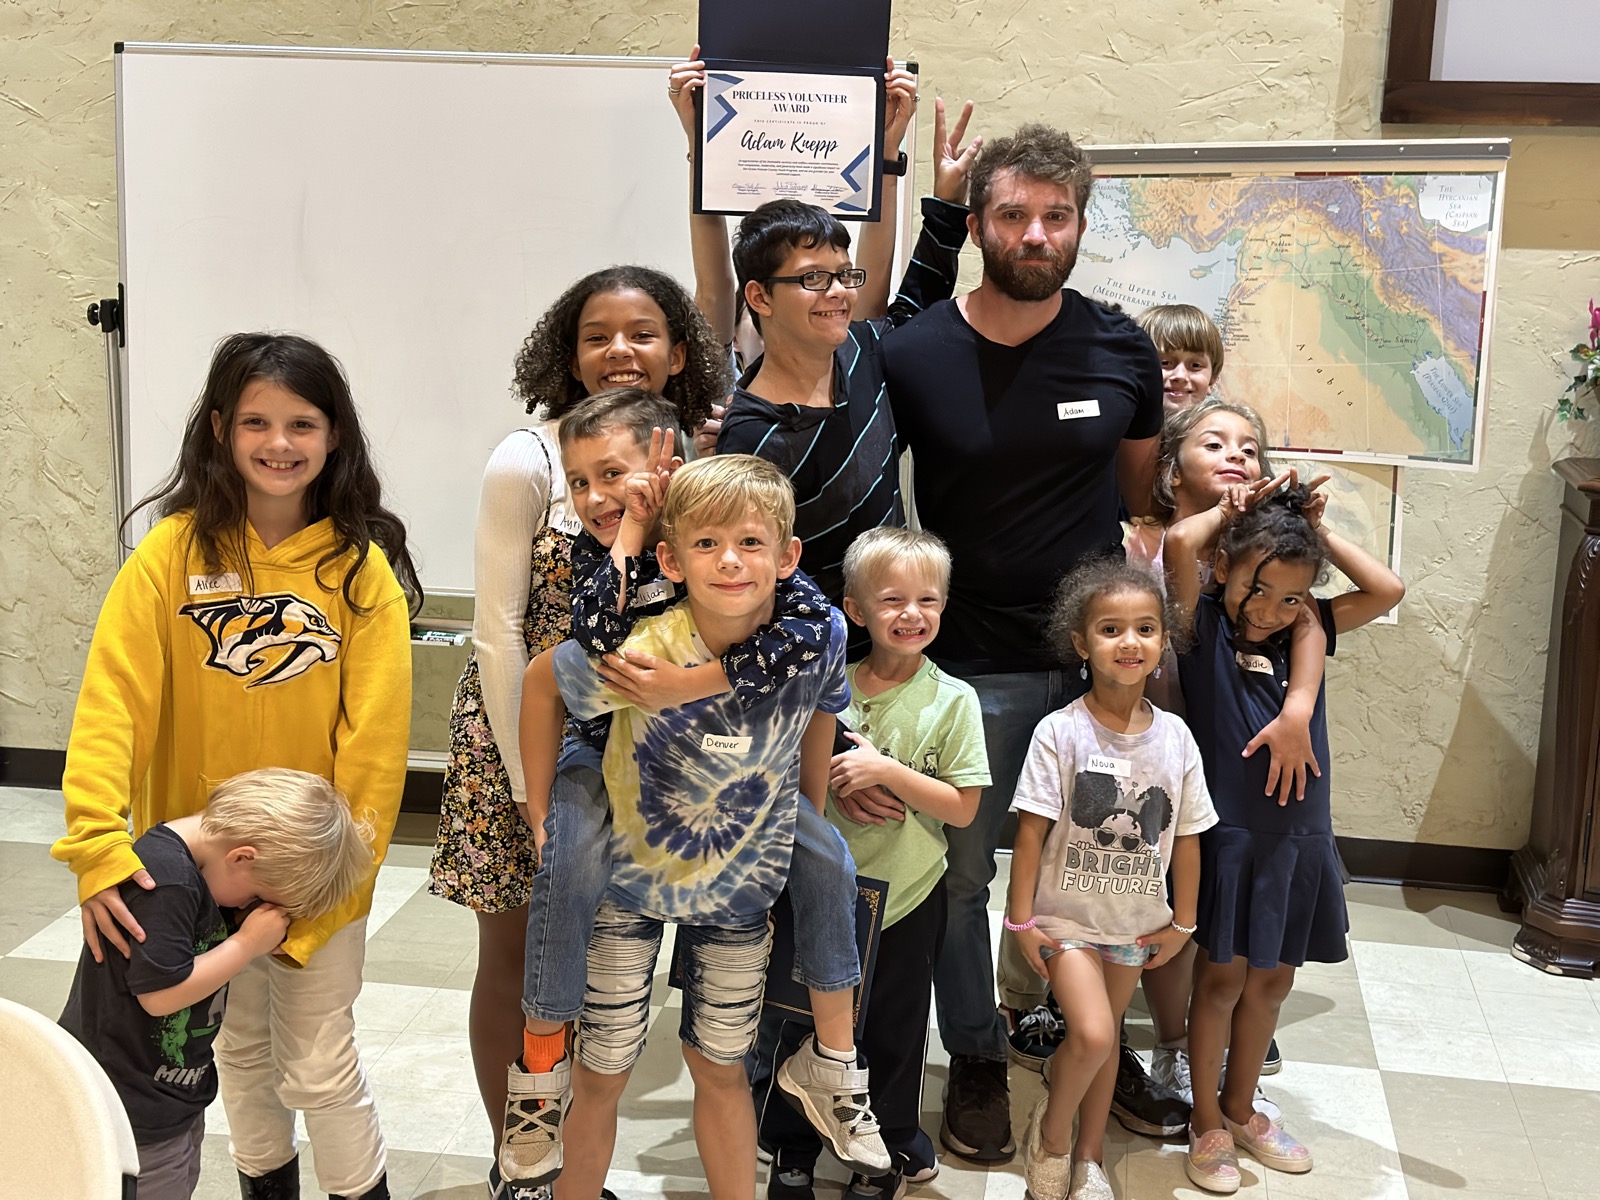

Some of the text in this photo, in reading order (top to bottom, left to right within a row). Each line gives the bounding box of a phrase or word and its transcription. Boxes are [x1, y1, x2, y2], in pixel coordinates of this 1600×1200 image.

[732, 90, 847, 104] PRICELESS VOLUNTEER
[771, 103, 810, 113] AWARD
[740, 129, 786, 151] Adam
[1063, 407, 1085, 418] Adam
[706, 737, 739, 749] Denver
[1091, 758, 1116, 769] Nova
[1064, 846, 1162, 878] BRIGHT
[1061, 871, 1162, 897] FUTURE
